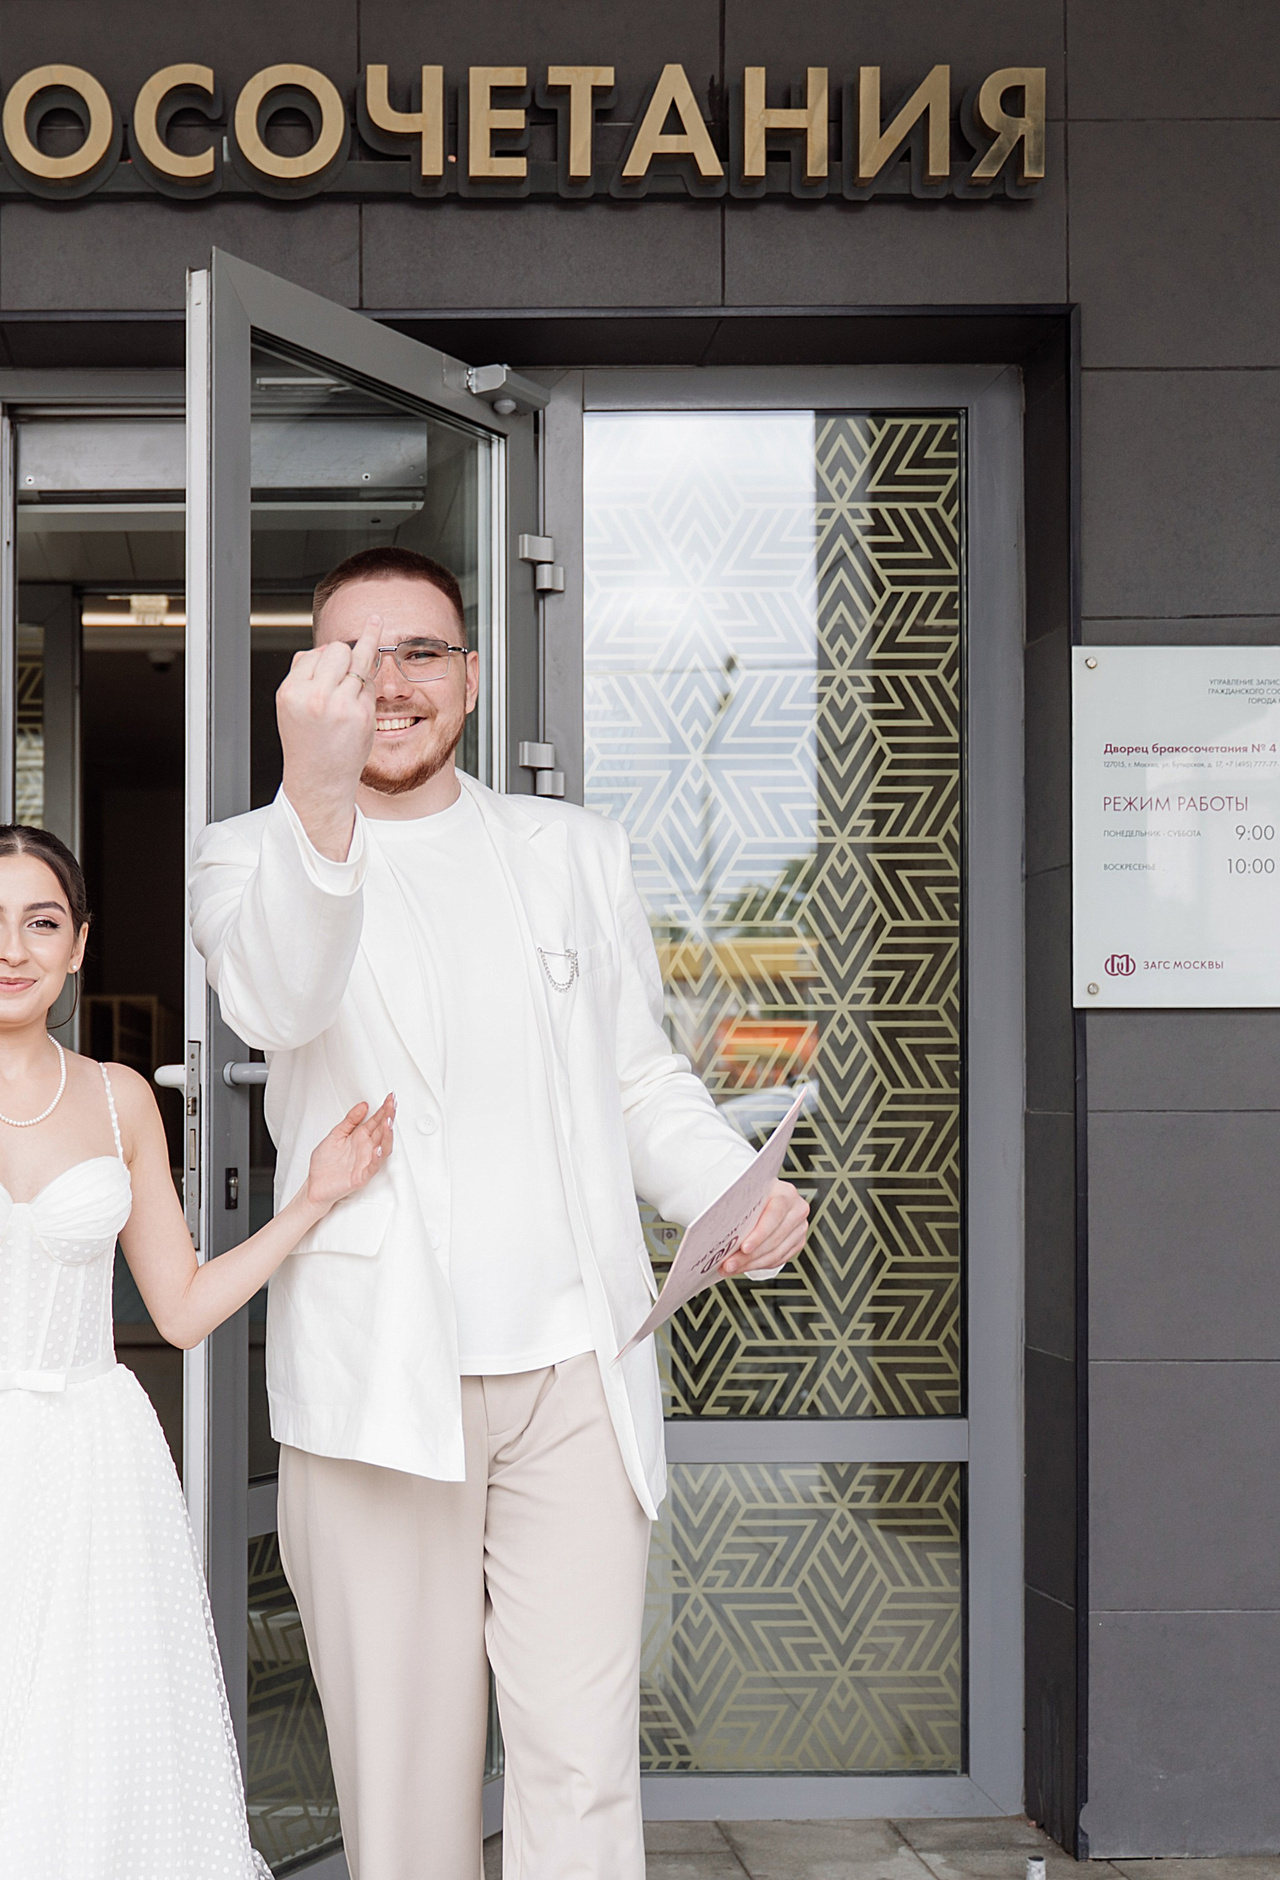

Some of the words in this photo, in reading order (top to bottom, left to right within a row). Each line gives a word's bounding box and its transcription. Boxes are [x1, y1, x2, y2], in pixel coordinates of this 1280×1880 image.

[1103, 743, 1149, 756] Дворец
[1151, 743, 1248, 756] бракосочетания
[1269, 743, 1277, 753] 4
[1103, 796, 1171, 812] РЕЖИМ
[1178, 796, 1248, 812] РАБОТЫ
[1103, 829, 1161, 838] ПОНЕДЕЛЬНИК
[1167, 829, 1201, 838] СУББОТА
[1235, 825, 1275, 840] 9:00
[1103, 863, 1156, 871] ВОСКРЕСЕНЬЕ
[1227, 858, 1275, 874] 10:00
[1143, 960, 1170, 969] ЗАГС
[1173, 960, 1224, 969] МОСКВЫ
